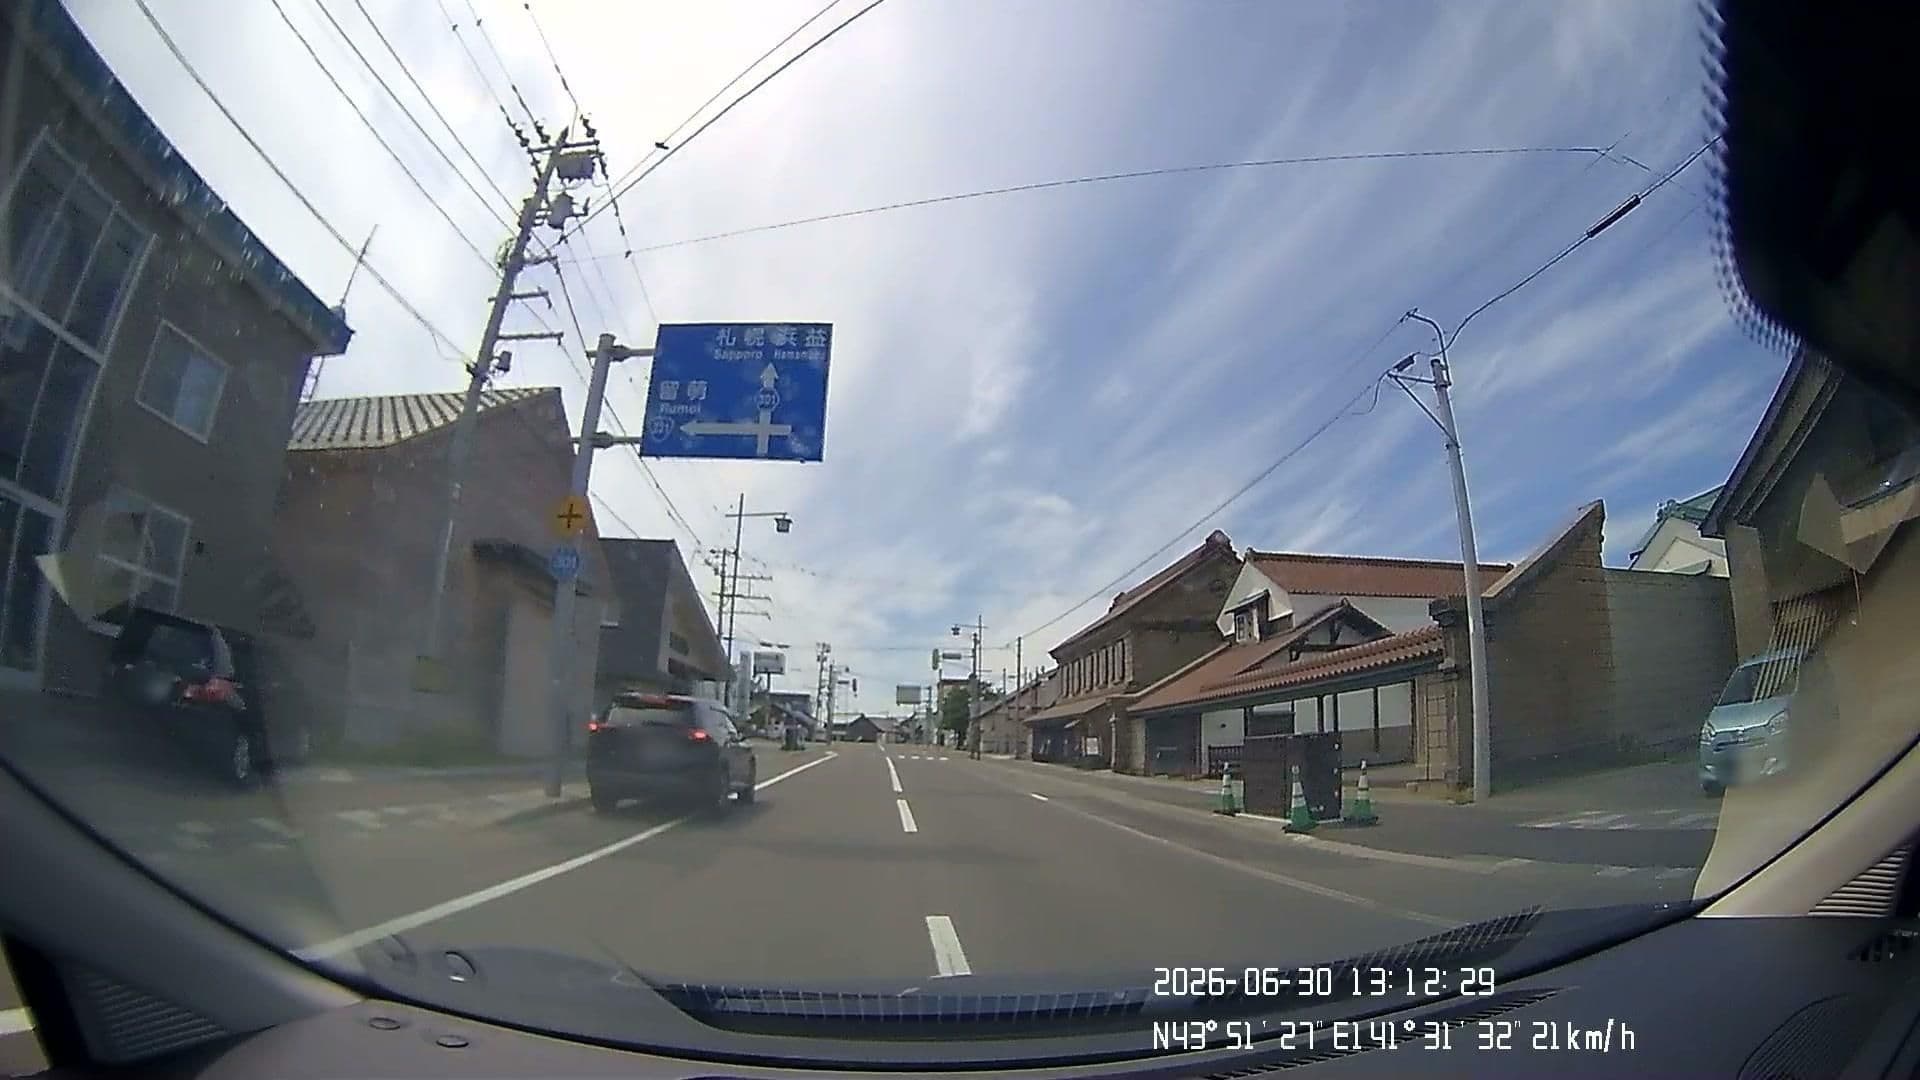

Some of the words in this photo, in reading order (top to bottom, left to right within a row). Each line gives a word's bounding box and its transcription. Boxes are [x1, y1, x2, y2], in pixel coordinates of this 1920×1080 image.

[714, 348, 764, 361] Sapporo
[773, 349, 826, 360] Hamam
[660, 402, 702, 415] Rumoi
